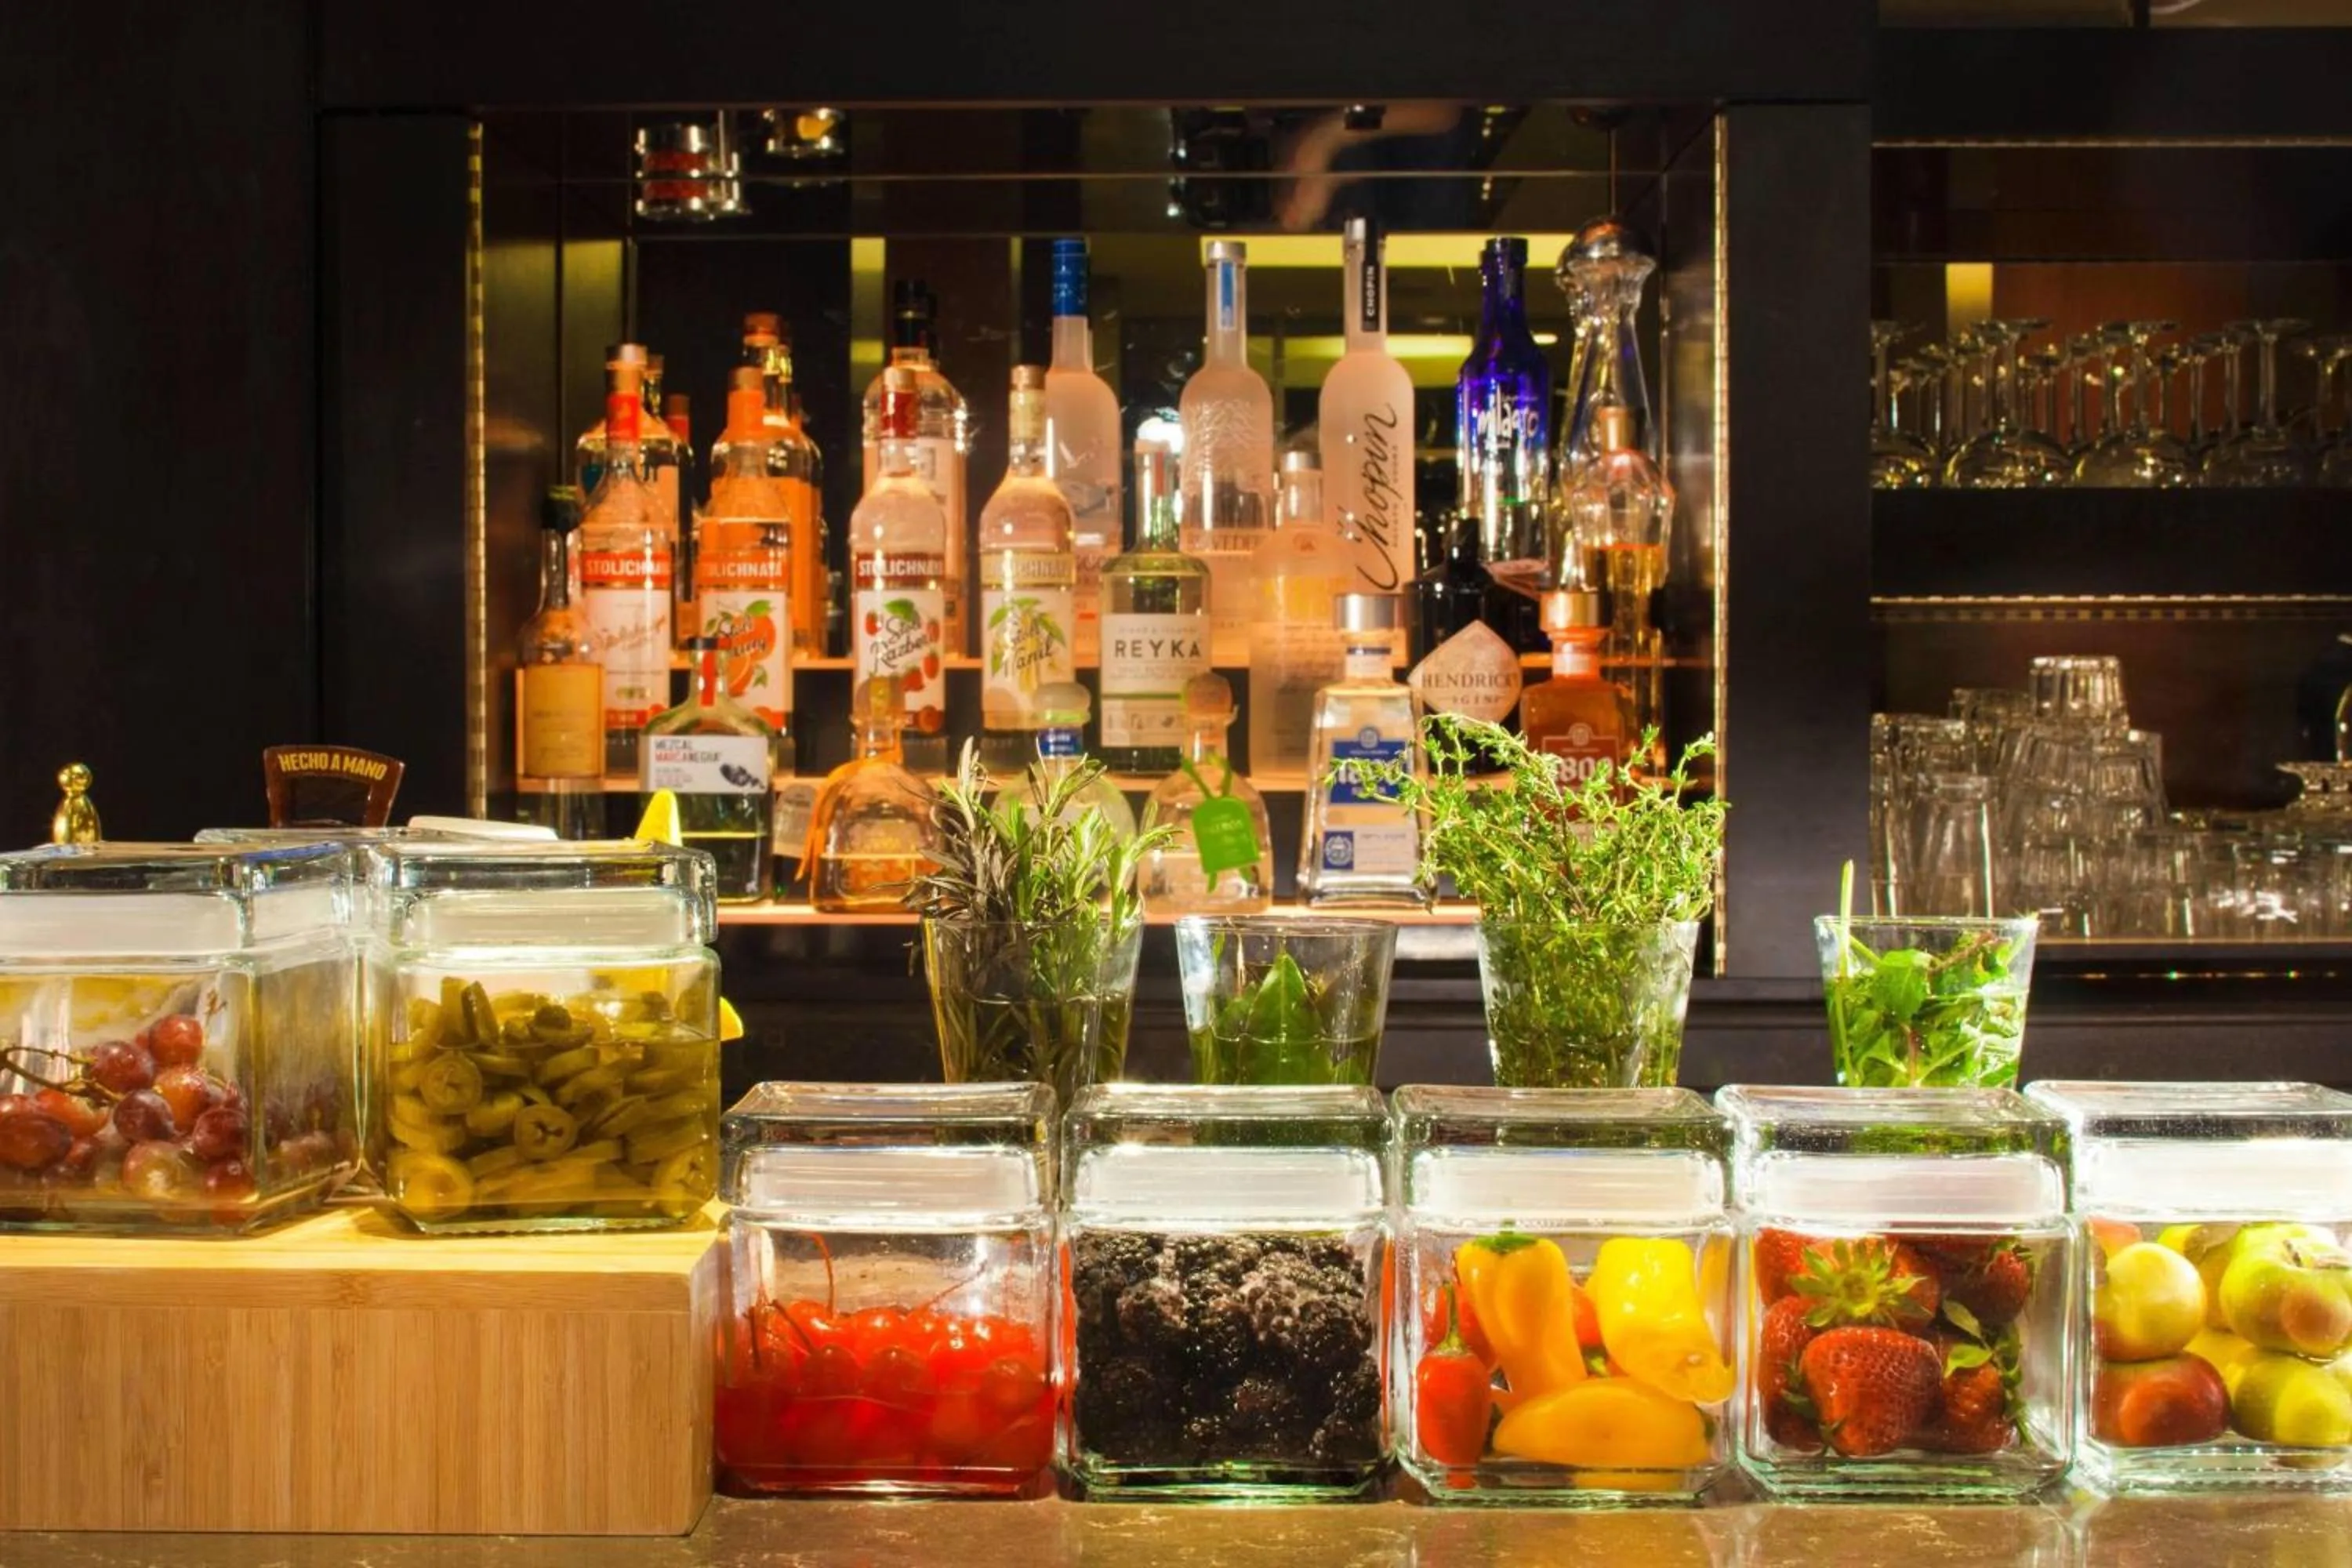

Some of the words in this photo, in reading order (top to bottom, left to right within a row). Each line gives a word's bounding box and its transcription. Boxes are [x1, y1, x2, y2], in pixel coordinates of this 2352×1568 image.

[1367, 266, 1376, 317] CHOPIN
[1355, 401, 1400, 591] Chopin
[1114, 639, 1201, 659] REYKA
[278, 752, 329, 772] HECHO
[330, 753, 340, 769] A
[343, 753, 388, 781] MANO
